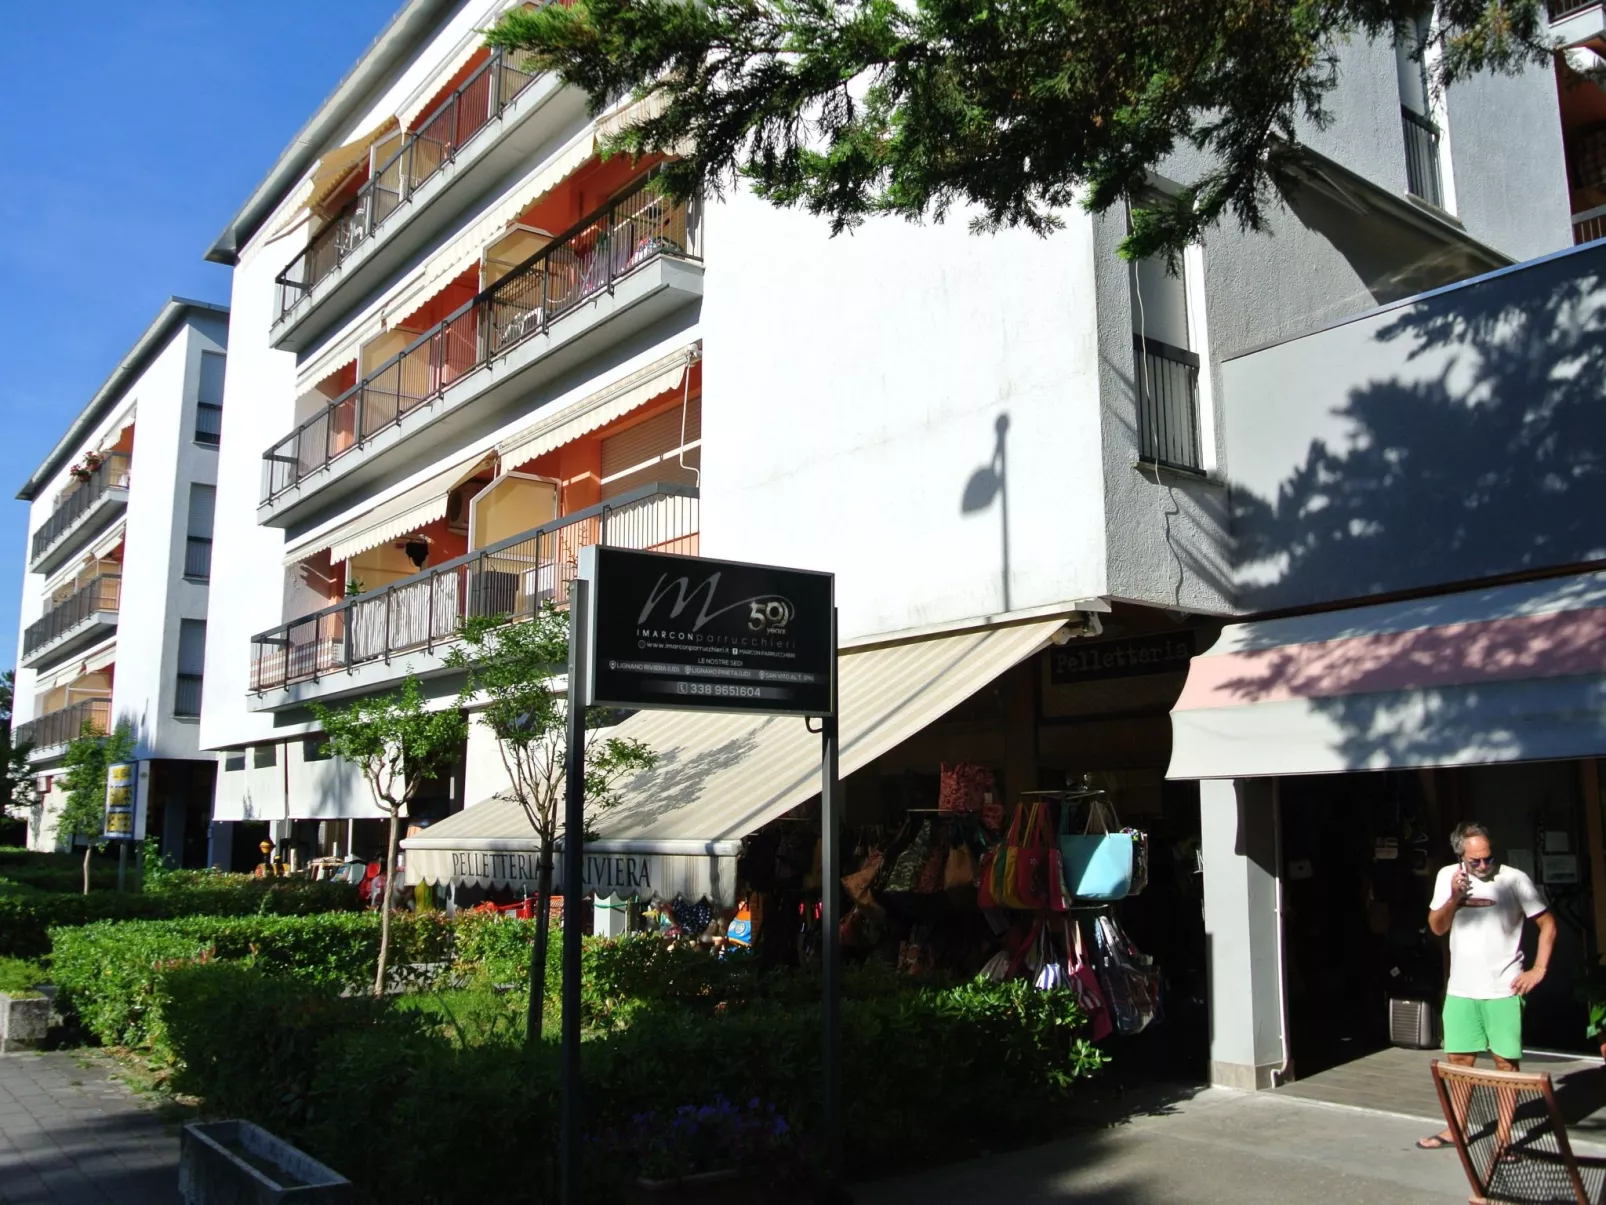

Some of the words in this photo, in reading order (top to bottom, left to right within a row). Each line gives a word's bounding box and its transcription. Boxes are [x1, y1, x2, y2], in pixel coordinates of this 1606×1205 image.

[748, 601, 788, 631] 50
[767, 627, 786, 635] years
[706, 658, 729, 666] NOSTRE
[1056, 640, 1189, 673] Pelletteria
[616, 662, 643, 670] LIGNANO
[644, 664, 667, 672] RIVIERA
[691, 667, 717, 675] LIGNANO
[690, 683, 712, 695] 338
[715, 685, 761, 697] 9651604
[582, 856, 651, 888] IVIERA
